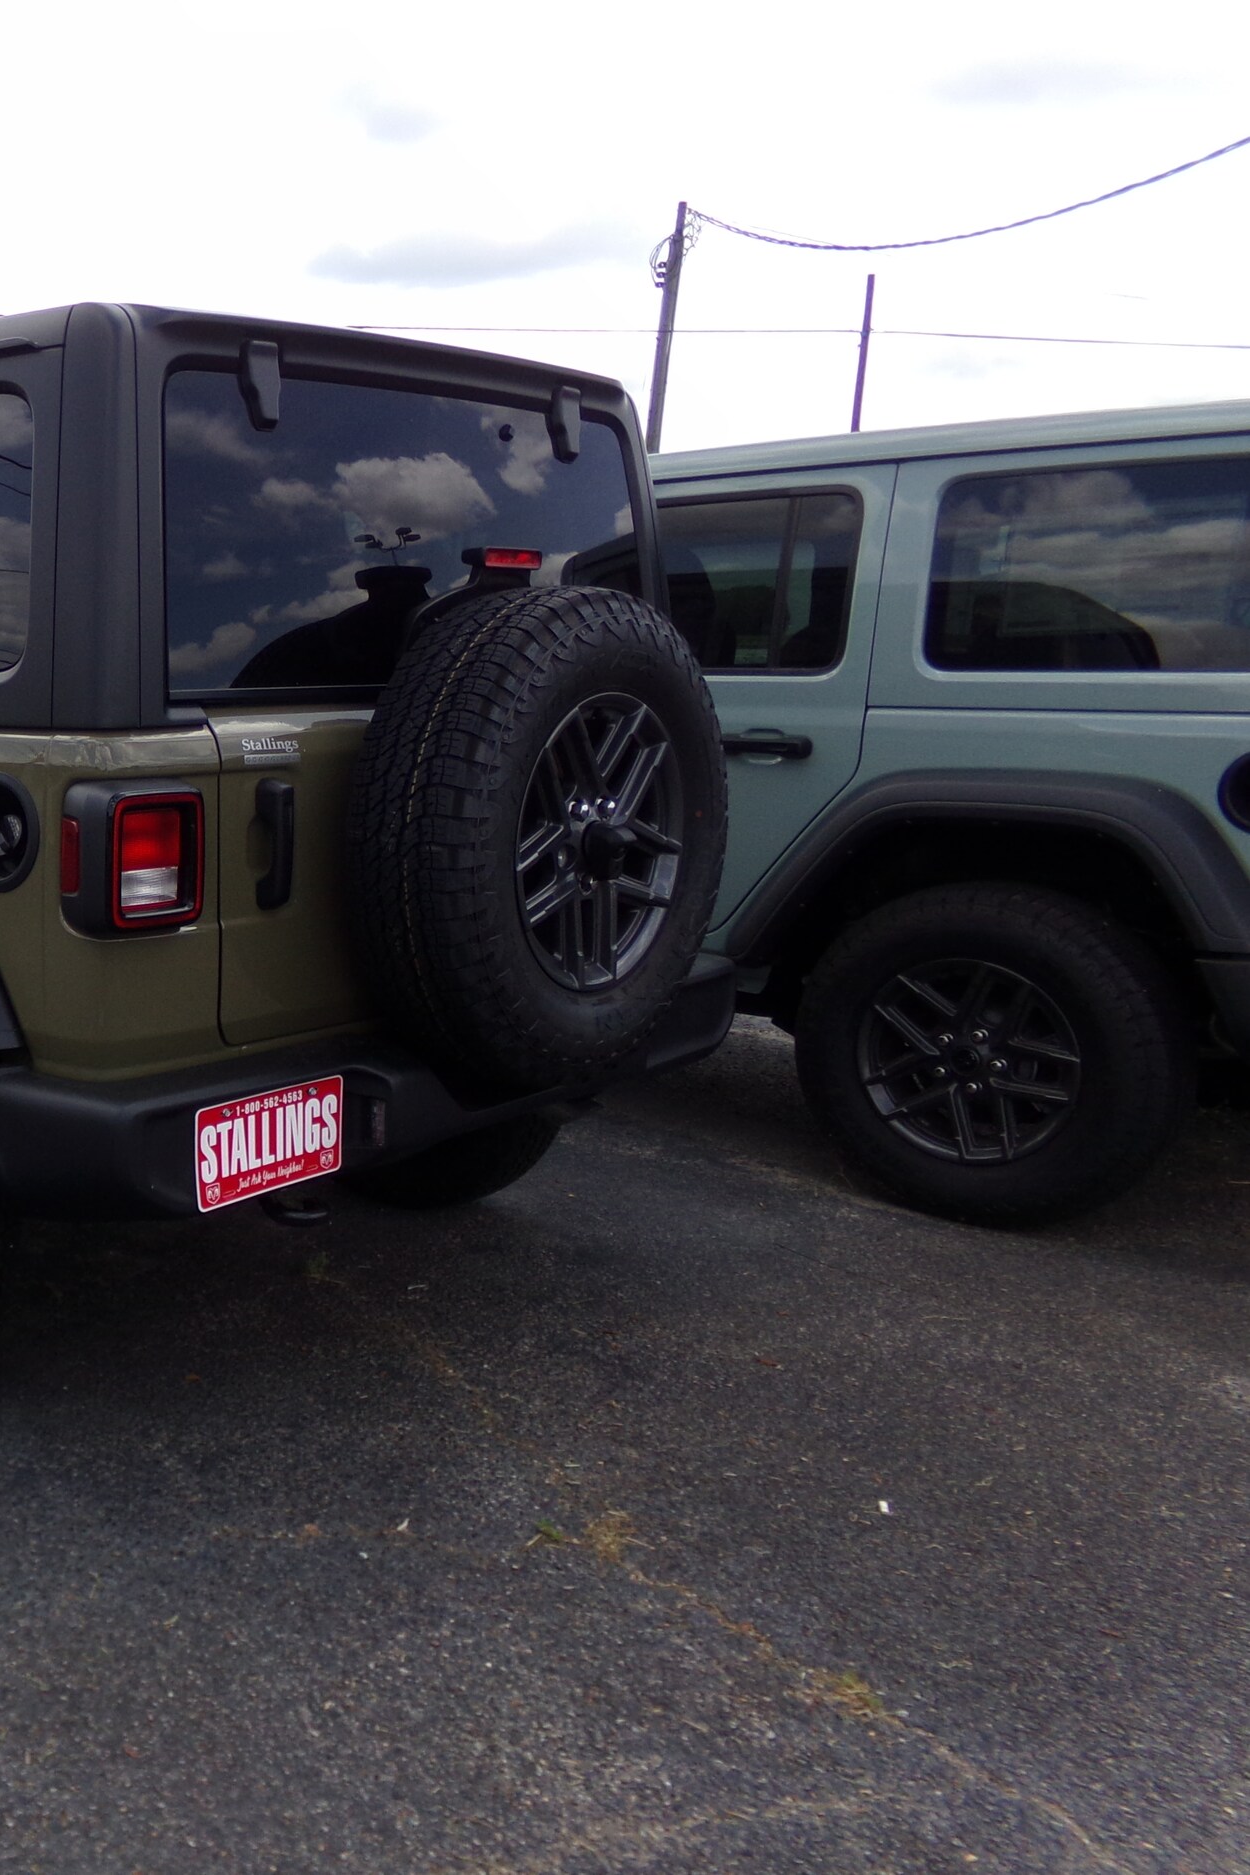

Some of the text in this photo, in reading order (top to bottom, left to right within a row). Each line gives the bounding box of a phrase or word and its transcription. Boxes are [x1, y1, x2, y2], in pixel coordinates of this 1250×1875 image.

[241, 737, 299, 753] Stallings
[235, 1089, 303, 1117] 1-800-562-4563
[200, 1093, 338, 1184] STALLINGS
[236, 1176, 250, 1193] Just
[262, 1170, 276, 1186] Your
